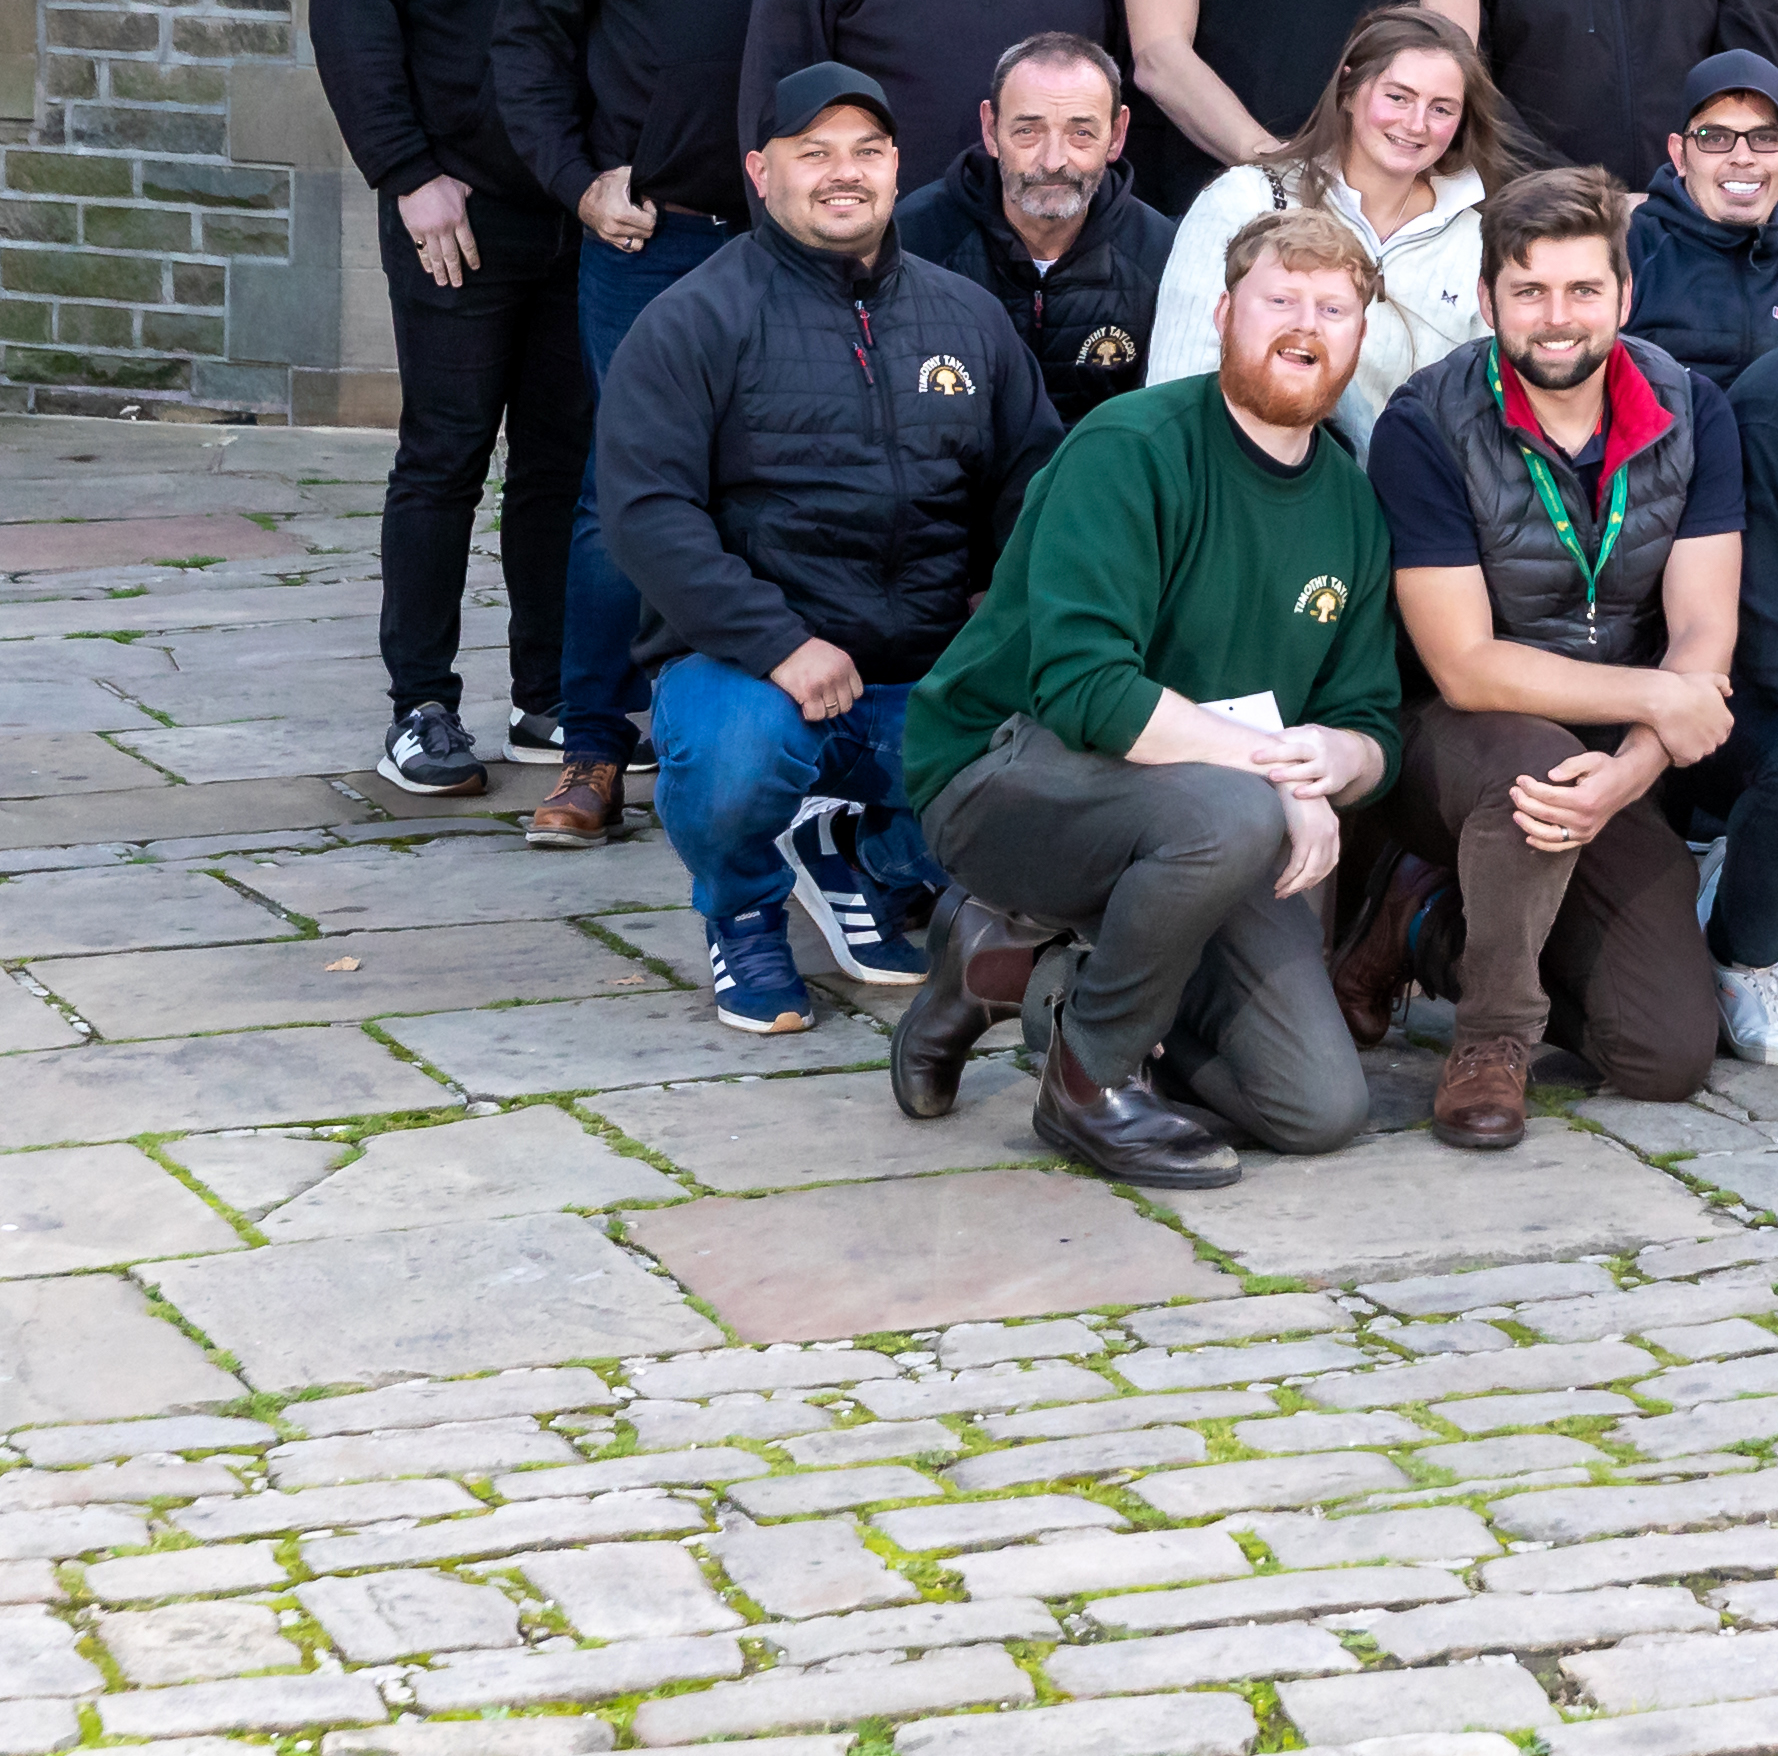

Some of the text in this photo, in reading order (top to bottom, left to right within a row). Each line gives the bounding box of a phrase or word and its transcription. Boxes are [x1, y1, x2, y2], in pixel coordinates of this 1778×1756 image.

[1075, 325, 1107, 366] TIMOTHY
[918, 354, 977, 396] TIMOTHY TAYLOR'S
[1293, 574, 1329, 614] TIMOTHY
